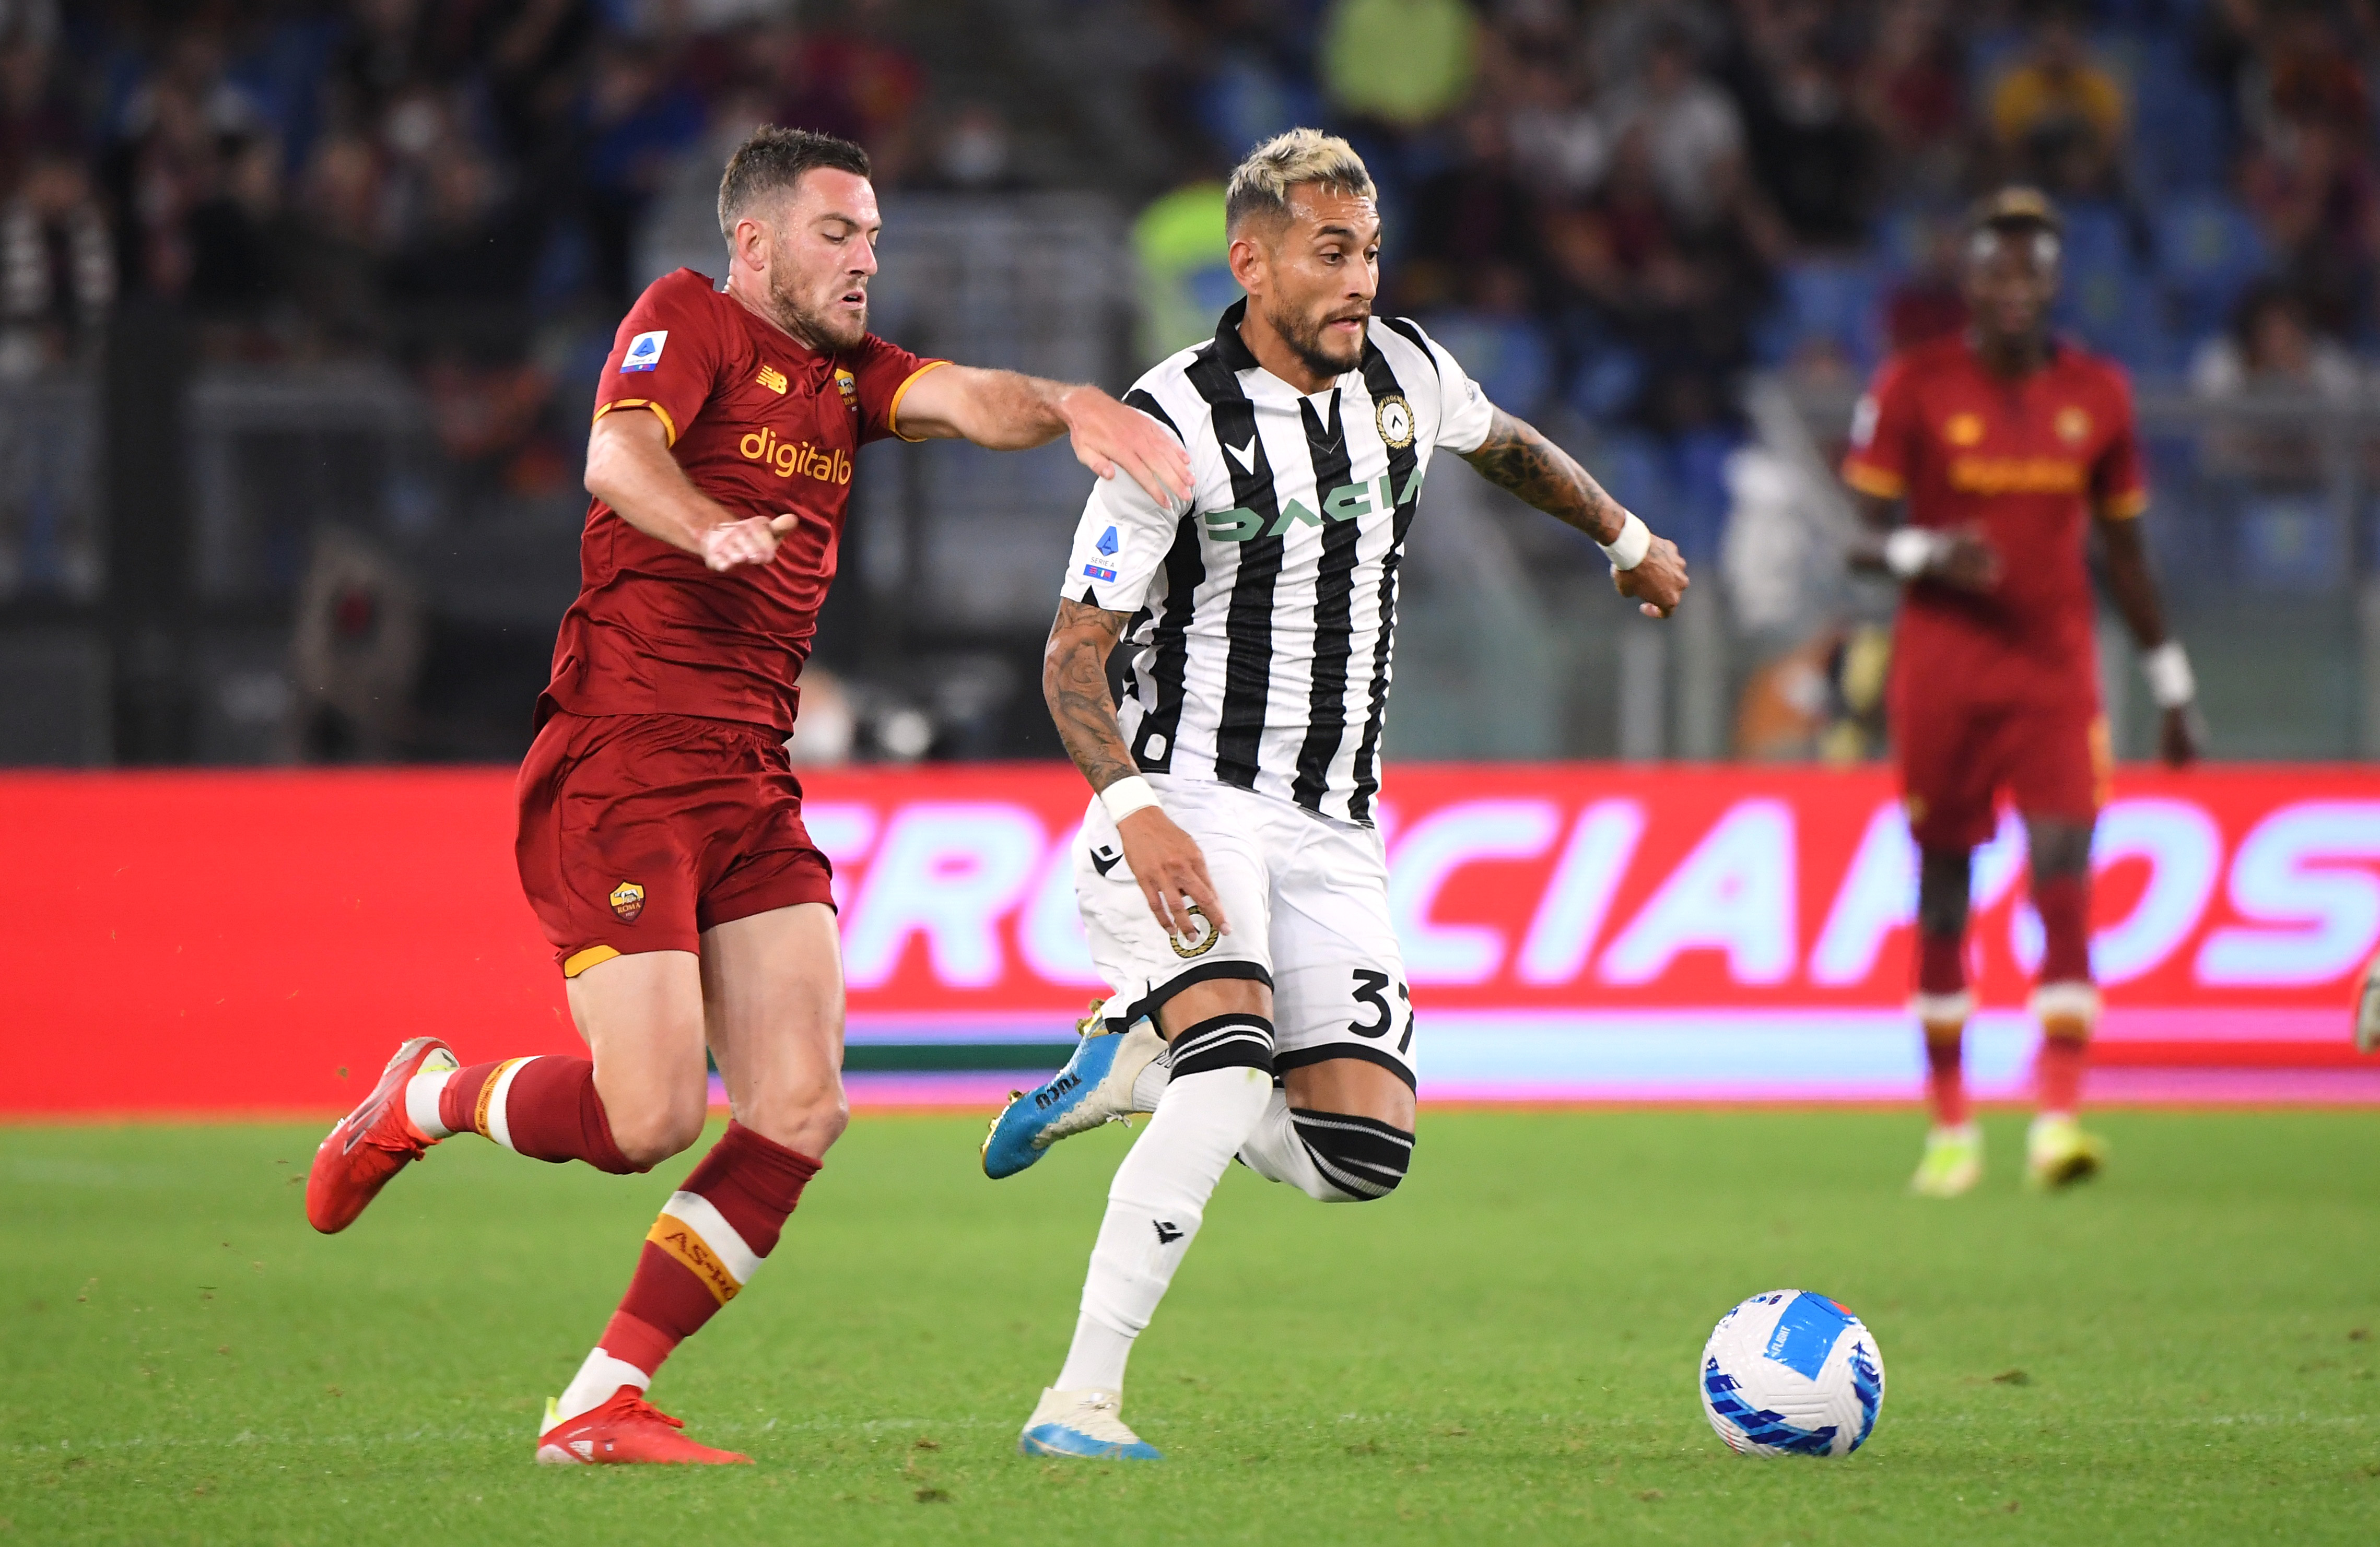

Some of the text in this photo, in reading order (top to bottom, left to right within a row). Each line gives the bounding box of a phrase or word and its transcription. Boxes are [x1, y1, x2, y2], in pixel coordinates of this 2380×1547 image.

[1383, 395, 1397, 405] 1896
[740, 427, 851, 485] digitalb
[1205, 465, 1425, 542] DACIA
[1091, 557, 1109, 566] SERIE
[617, 902, 641, 914] ROMA
[1347, 969, 1414, 1055] 37
[1035, 1071, 1082, 1110] TUCU
